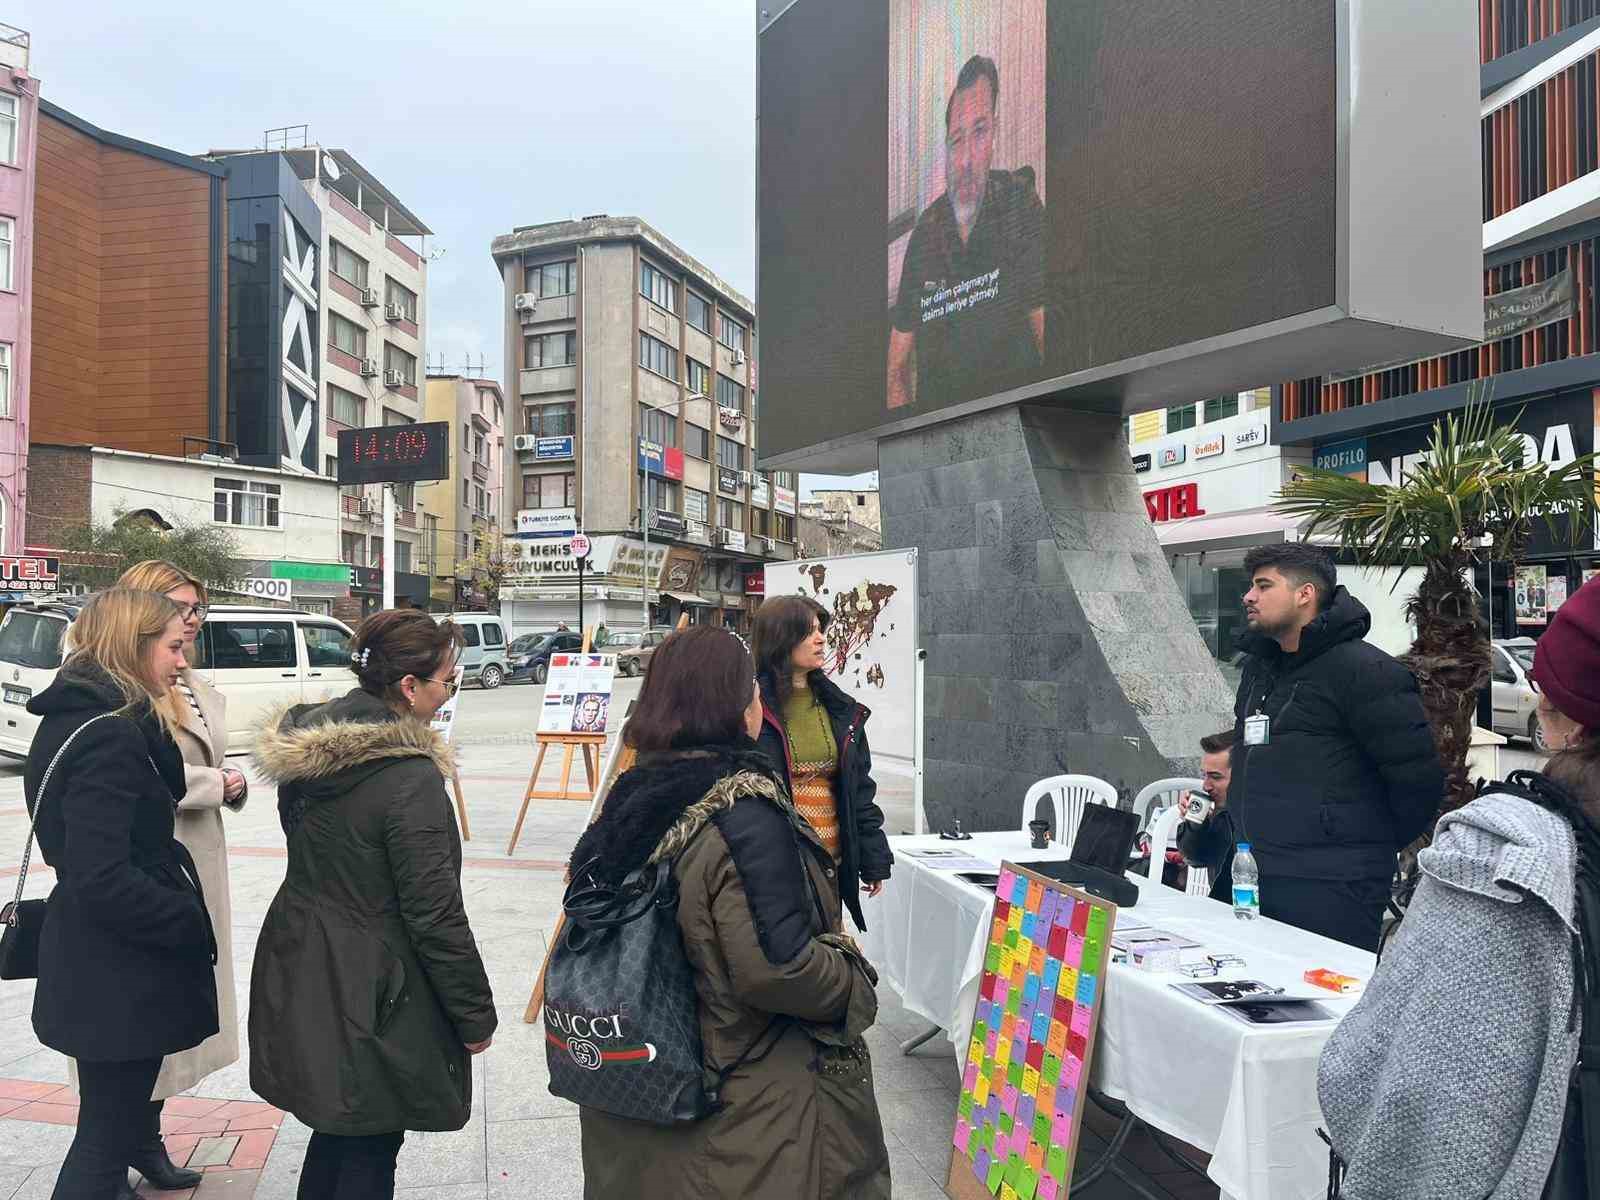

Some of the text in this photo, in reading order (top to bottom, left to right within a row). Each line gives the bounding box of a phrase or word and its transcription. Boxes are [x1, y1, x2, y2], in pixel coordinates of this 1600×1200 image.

[933, 287, 952, 302] daim
[354, 430, 427, 464] 14:09
[571, 539, 587, 549] OTEL
[510, 559, 594, 573] UYUMCULK
[246, 579, 288, 597] FOOD
[545, 1005, 625, 1039] GUCCI
